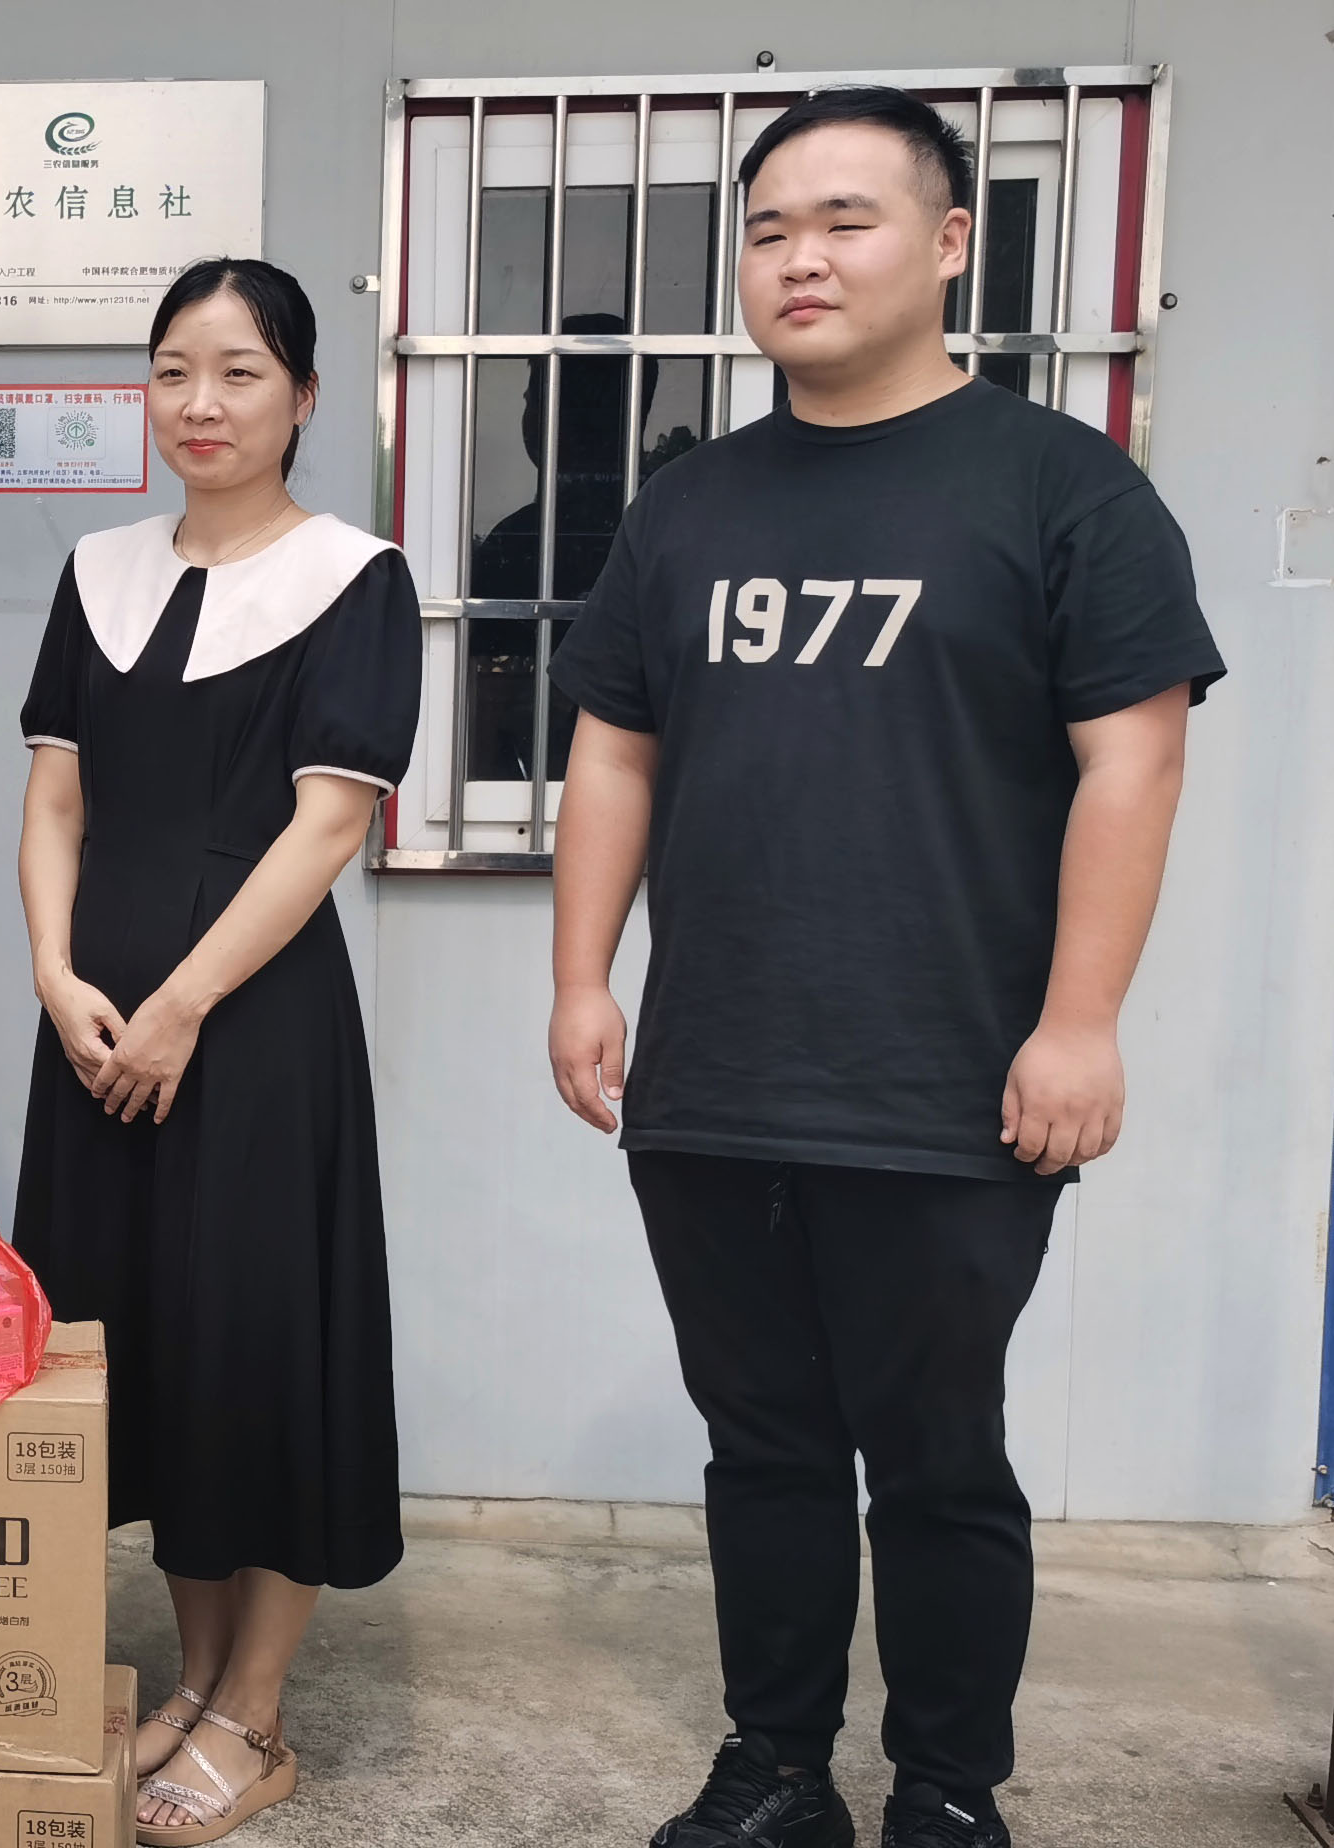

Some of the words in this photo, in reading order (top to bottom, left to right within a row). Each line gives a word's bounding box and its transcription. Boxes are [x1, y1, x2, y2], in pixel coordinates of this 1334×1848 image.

[708, 578, 923, 667] 1977
[15, 1441, 77, 1460] 18包装
[15, 1462, 36, 1475] 3层
[40, 1463, 76, 1476] 150抽
[25, 1819, 86, 1839] 18包装
